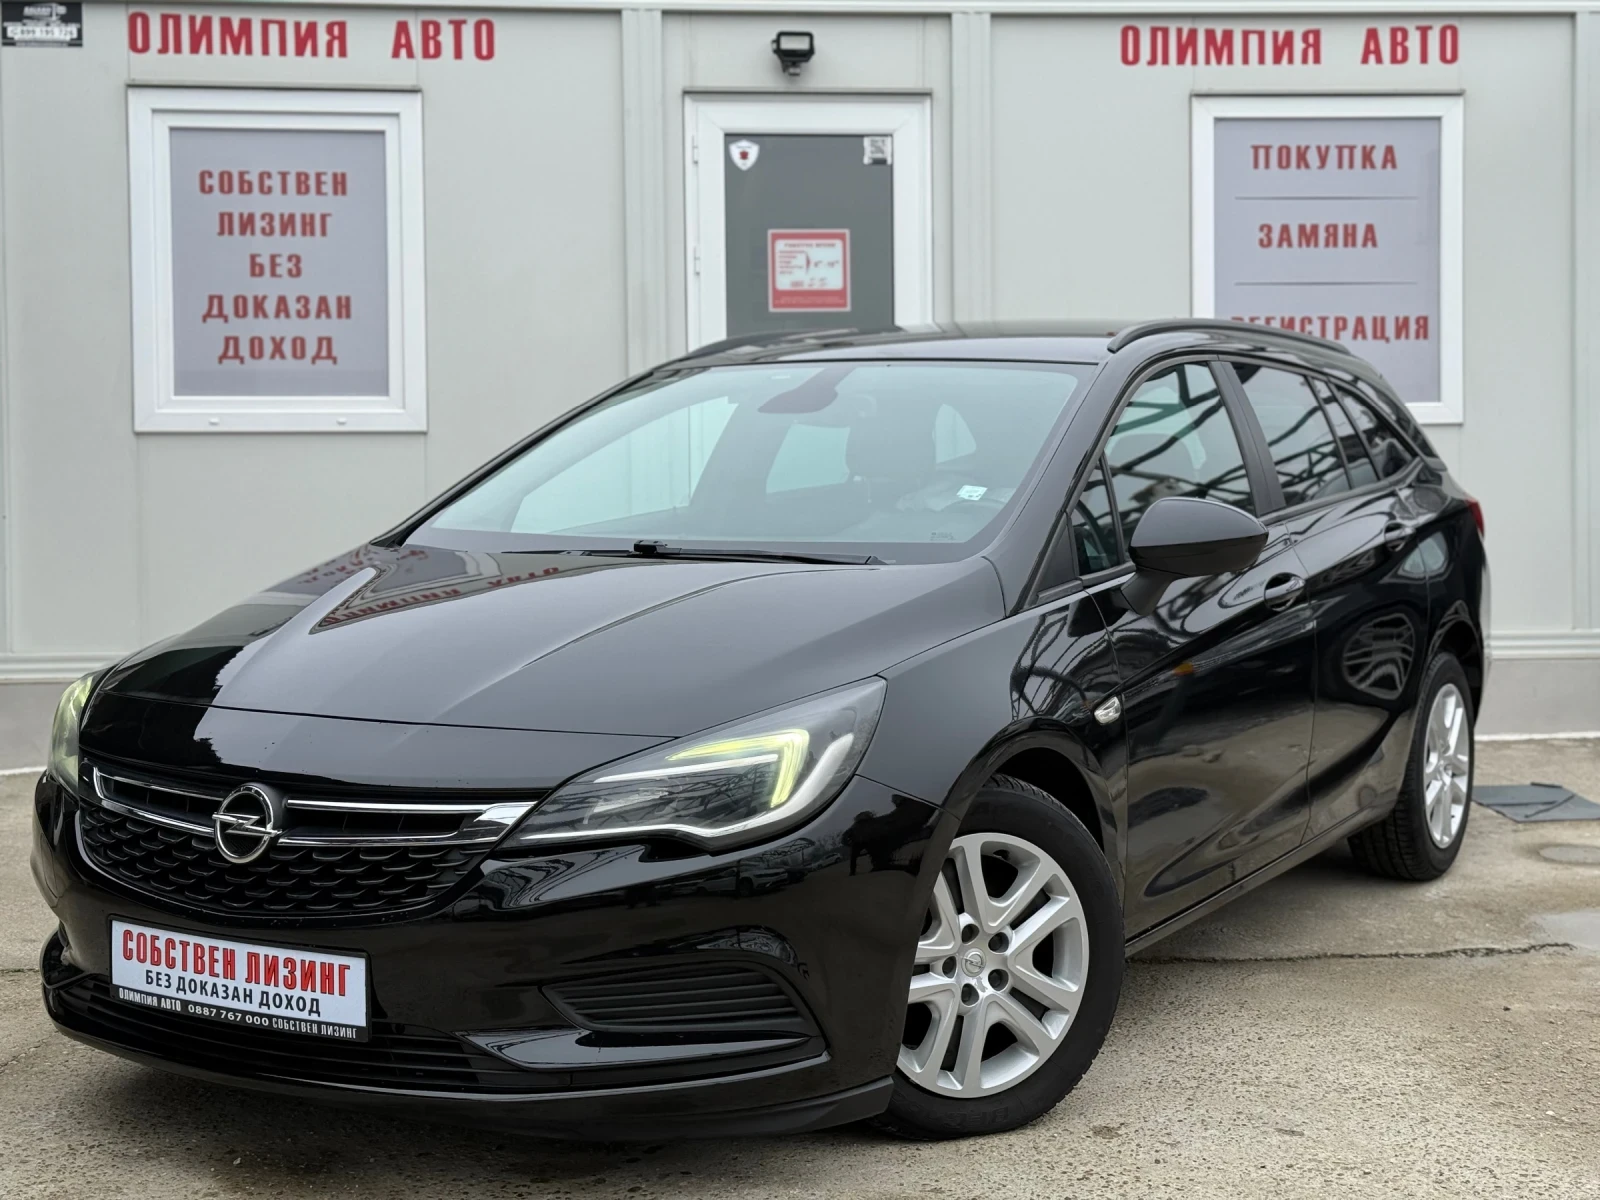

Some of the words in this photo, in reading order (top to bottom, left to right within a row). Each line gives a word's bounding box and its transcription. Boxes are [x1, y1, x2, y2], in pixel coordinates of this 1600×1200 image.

[128, 12, 348, 58] ОЛИМПИЯ
[391, 19, 495, 61] АВТО
[1120, 25, 1322, 66] ОЛИМПИЯ
[1361, 24, 1460, 65] АВТО
[1251, 145, 1397, 170] ПОКУПКА
[199, 170, 348, 196] СОБСТВЕН
[217, 212, 332, 237] ЛИЗИНГ
[1258, 223, 1378, 249] ЗАМЯНА
[249, 254, 302, 278] БЕЗ
[203, 295, 351, 323] ДОКАЗАН
[1231, 315, 1429, 343] ИСТРАЦИЯ
[218, 336, 337, 364] ДОХОД
[122, 929, 236, 980] СОБСТВЕН
[245, 951, 350, 997] ЛИЗИНГ
[145, 969, 172, 989] БЕЗ
[176, 976, 253, 1005] ДОКАЗАН
[258, 991, 321, 1017] ДОХОД
[119, 987, 158, 1007] ОЛИМПИЯ
[160, 996, 181, 1012] АВТО
[188, 1004, 217, 1017] 0887
[219, 1010, 242, 1022] 767
[245, 1014, 269, 1026] 000
[272, 1017, 318, 1034] СОБСТВЕН
[320, 1024, 357, 1039] ЛИЗИНГ
